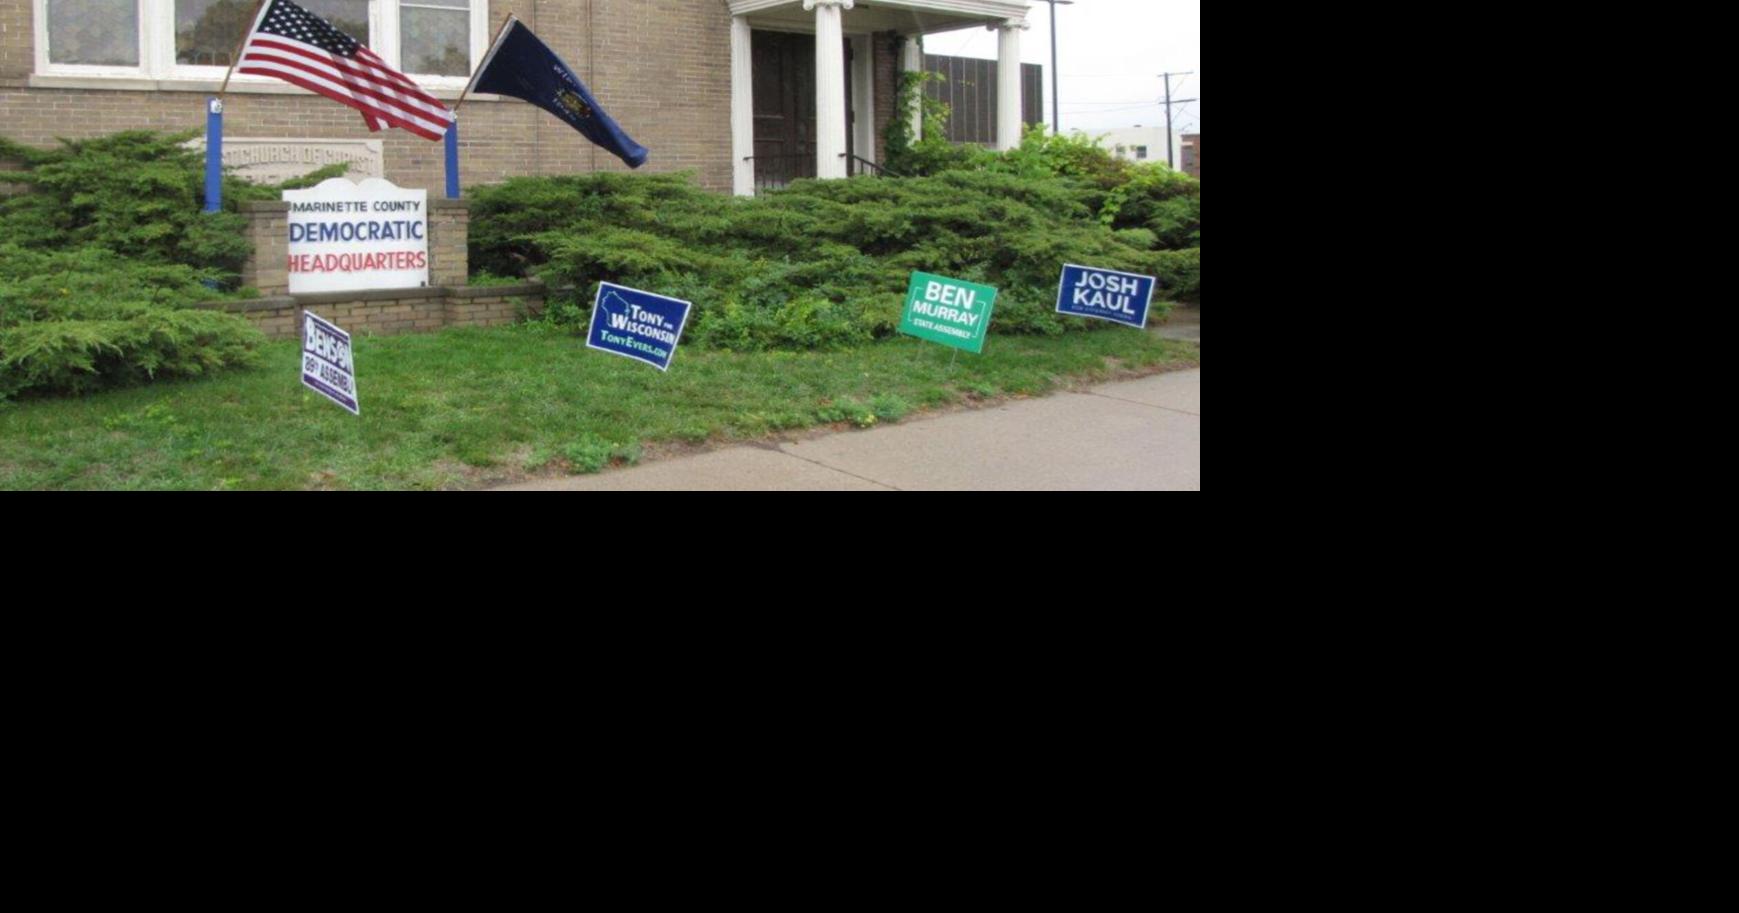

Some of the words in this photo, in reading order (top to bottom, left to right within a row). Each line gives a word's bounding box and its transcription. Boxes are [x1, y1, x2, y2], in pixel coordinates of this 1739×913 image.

[240, 145, 300, 164] CHURCH
[303, 146, 321, 164] OF
[292, 201, 368, 213] MARINETTE
[373, 200, 421, 212] COUNTY
[289, 220, 424, 243] DEMOCRATIC
[287, 250, 426, 273] HEADQUARTERS
[924, 280, 976, 310] BEN
[1074, 271, 1138, 296] JOSH
[1073, 287, 1135, 314] KAUL
[630, 303, 665, 327] TONY
[912, 300, 979, 327] MURRAY
[611, 312, 676, 344] WISCONSIN
